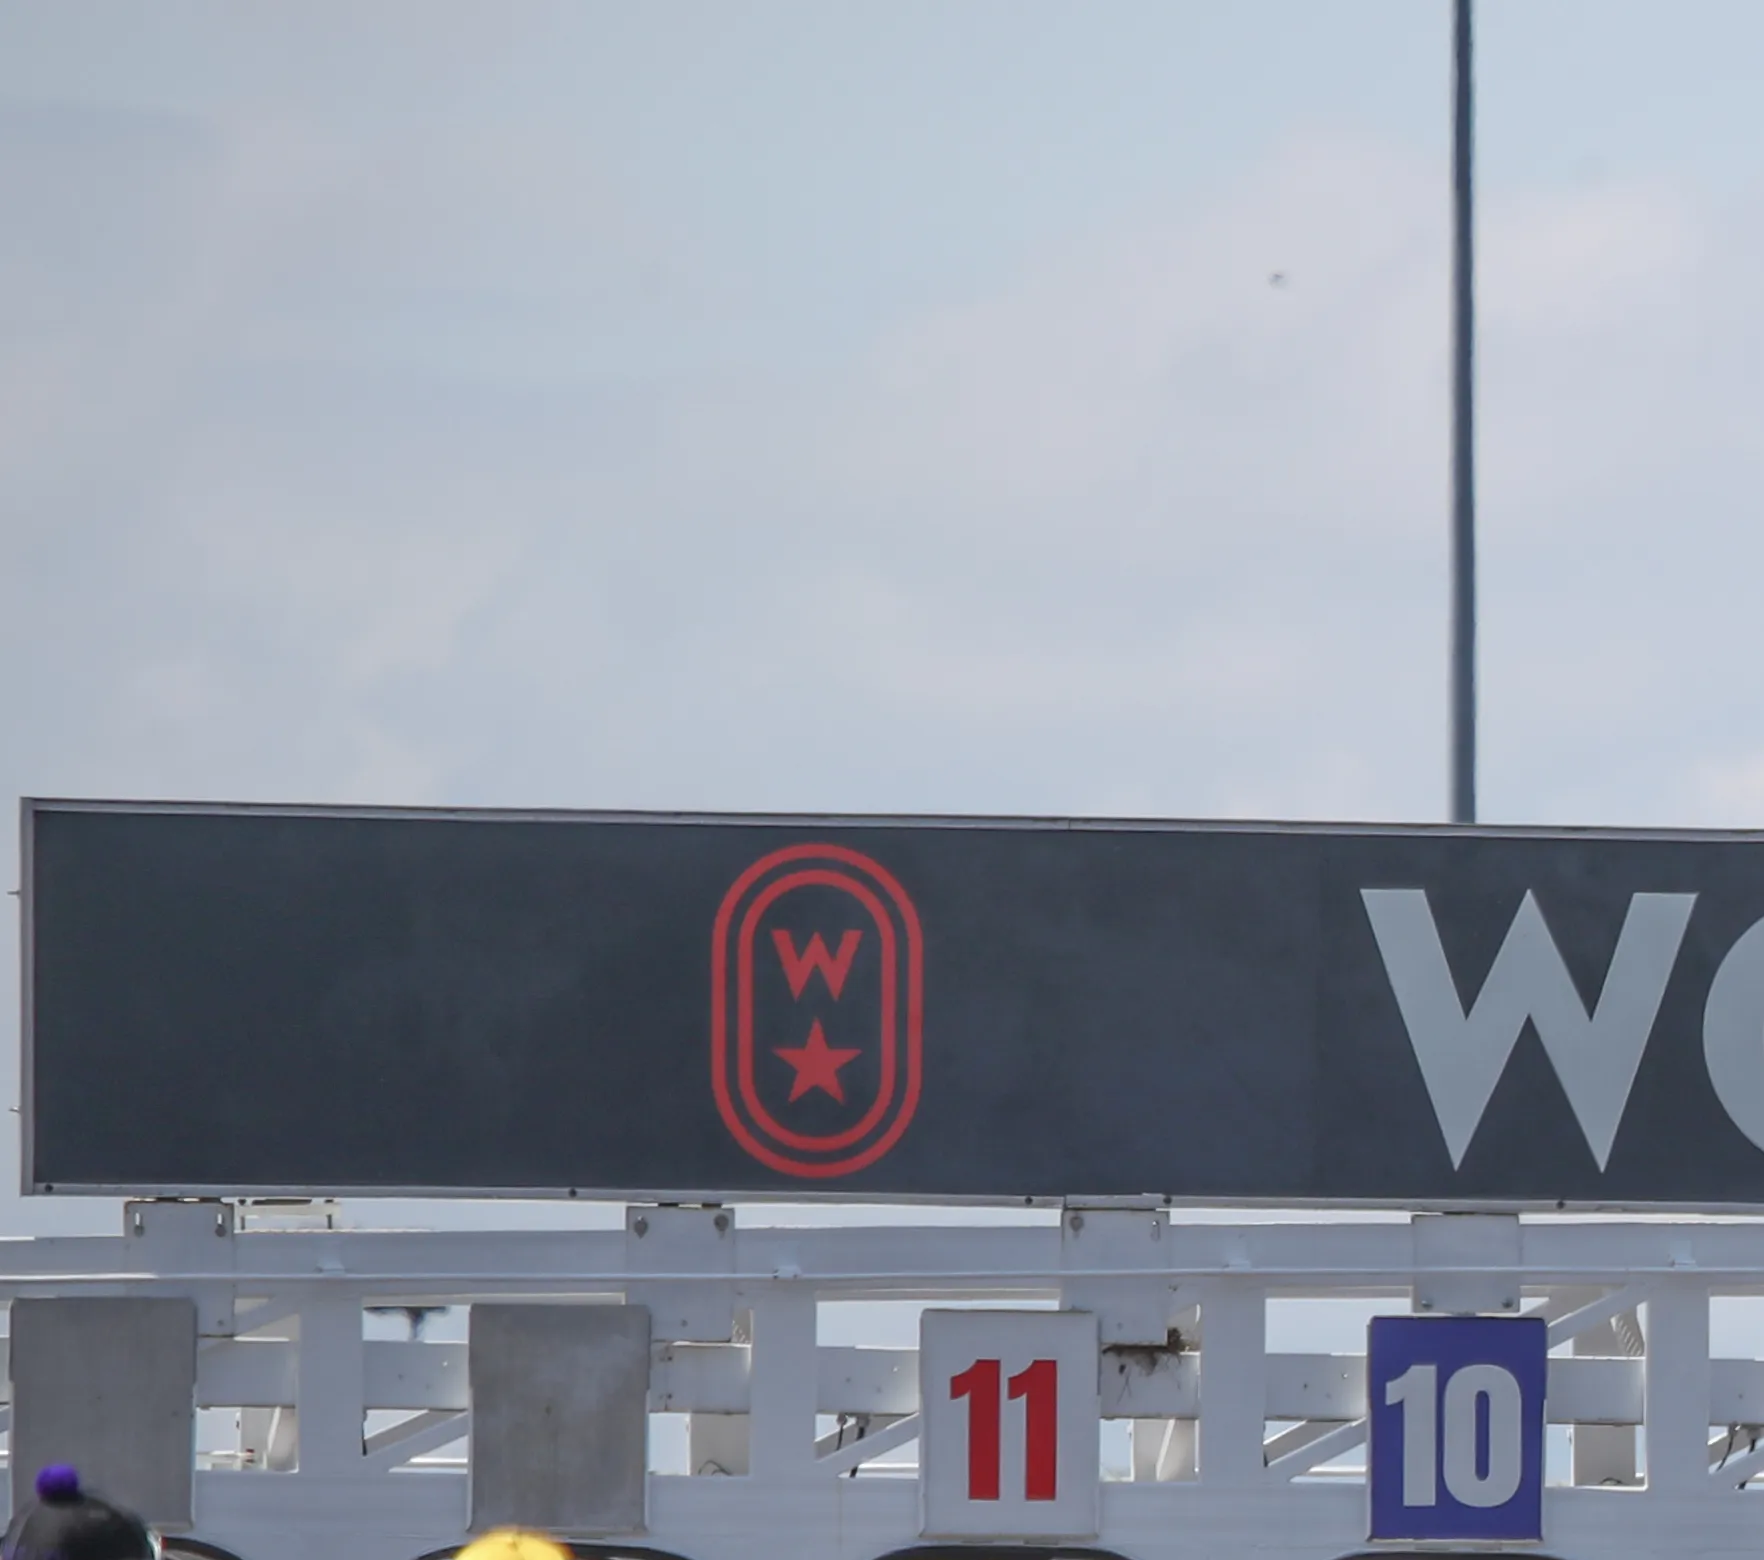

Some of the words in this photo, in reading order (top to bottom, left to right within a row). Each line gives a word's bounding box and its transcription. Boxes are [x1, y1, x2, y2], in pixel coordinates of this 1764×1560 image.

[772, 929, 862, 1000] W
[950, 1359, 1057, 1500] 11
[1385, 1363, 1523, 1508] 10
